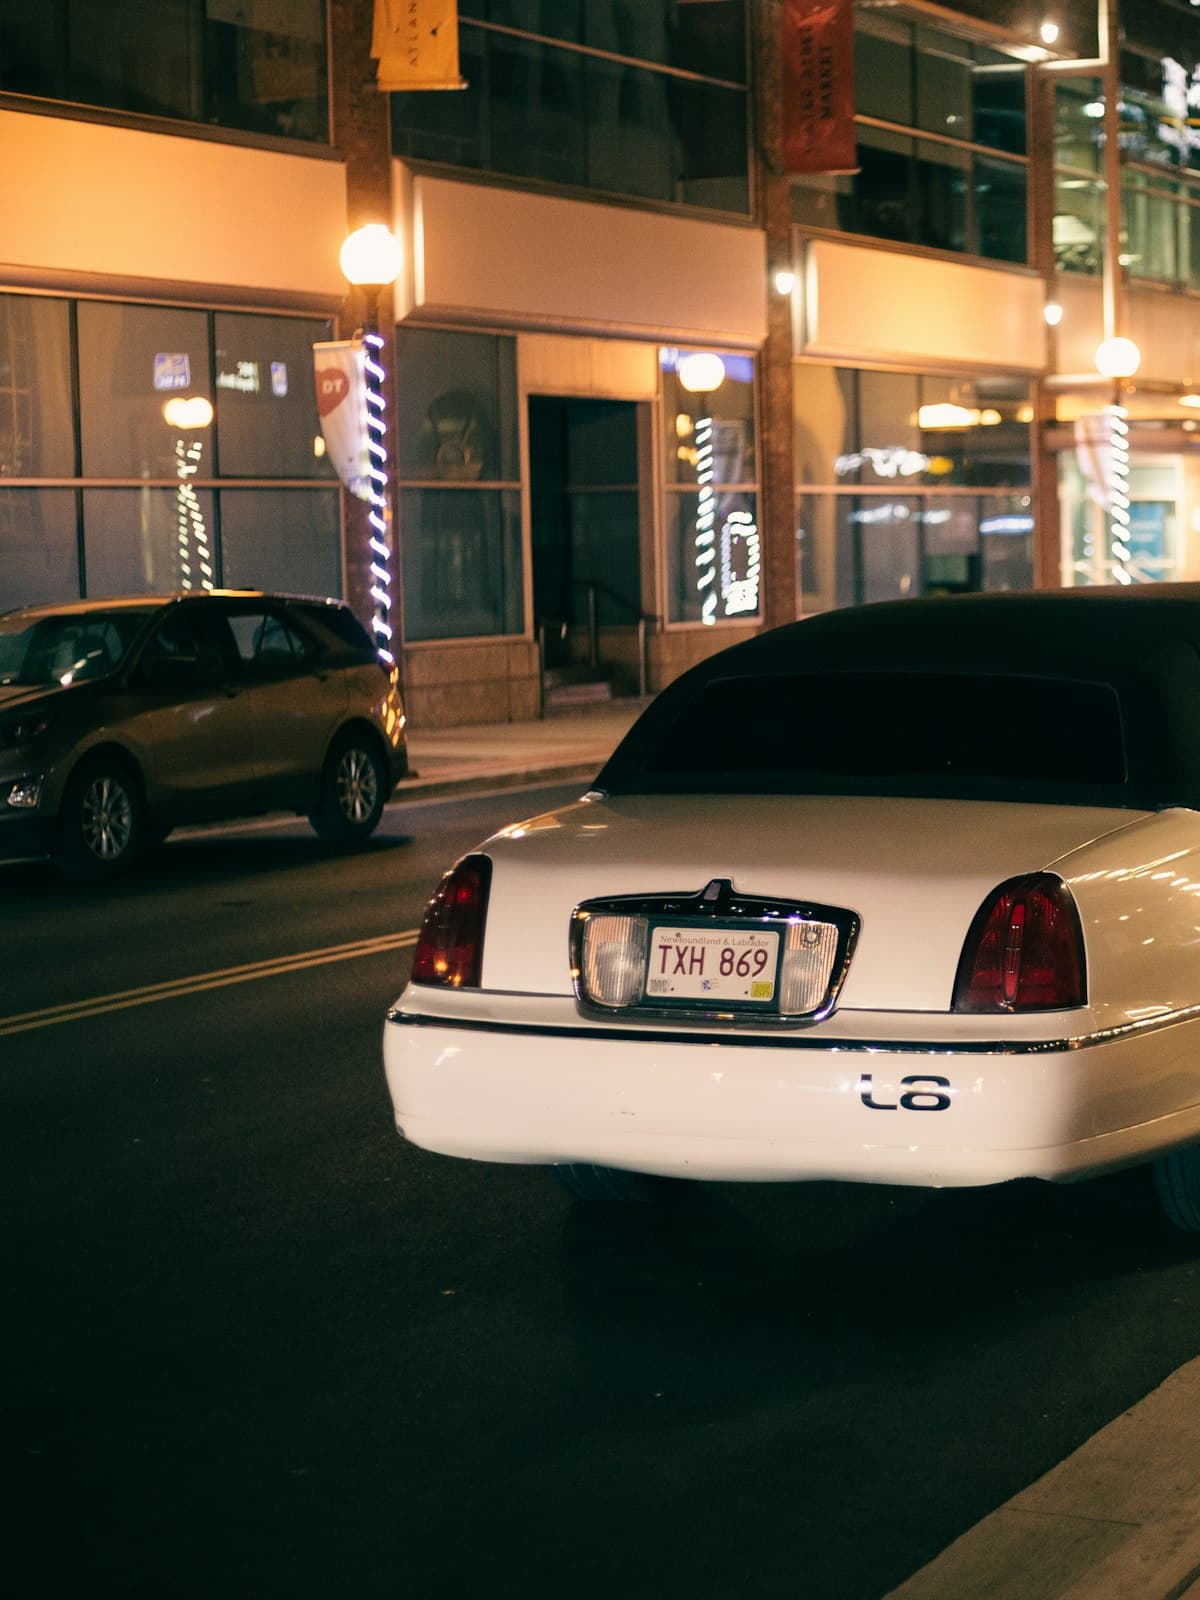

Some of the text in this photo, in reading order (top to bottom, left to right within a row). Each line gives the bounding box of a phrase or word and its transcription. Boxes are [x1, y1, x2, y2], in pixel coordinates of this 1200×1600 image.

[322, 378, 344, 394] DT
[660, 935, 769, 947] Newfoundland & Labrador
[658, 944, 768, 978] TXH 869
